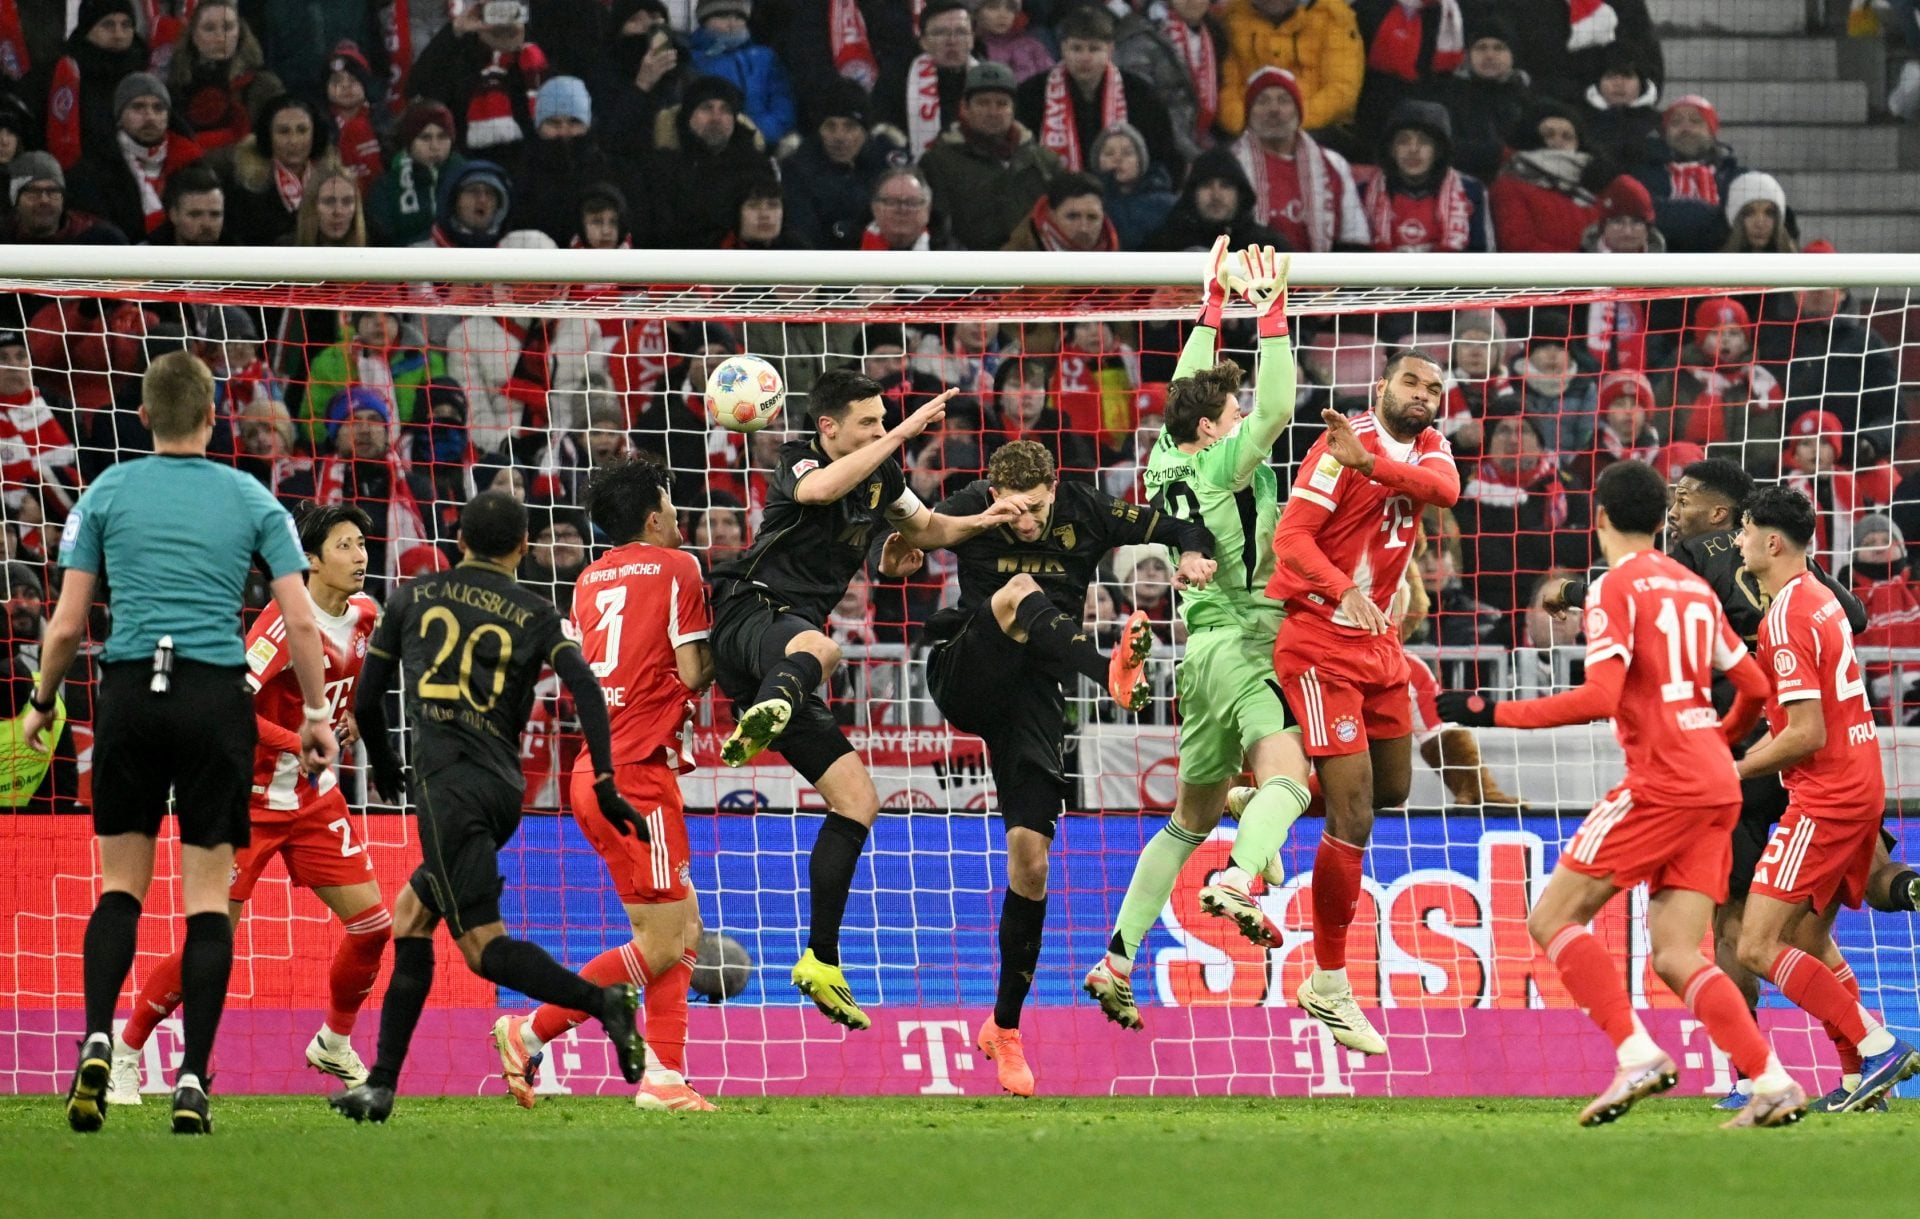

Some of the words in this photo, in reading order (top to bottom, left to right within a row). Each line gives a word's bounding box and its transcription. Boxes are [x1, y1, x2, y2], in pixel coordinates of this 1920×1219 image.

[1061, 356, 1089, 392] FC
[1381, 494, 1414, 549] T
[1703, 536, 1728, 557] FC
[413, 582, 437, 603] FC
[588, 567, 618, 584] BAYERN
[418, 605, 513, 713] 20
[594, 585, 628, 678] 3
[1655, 597, 1716, 703] 10
[850, 731, 955, 752] BAYERN
[897, 1020, 975, 1095] T
[1290, 1018, 1365, 1095] T
